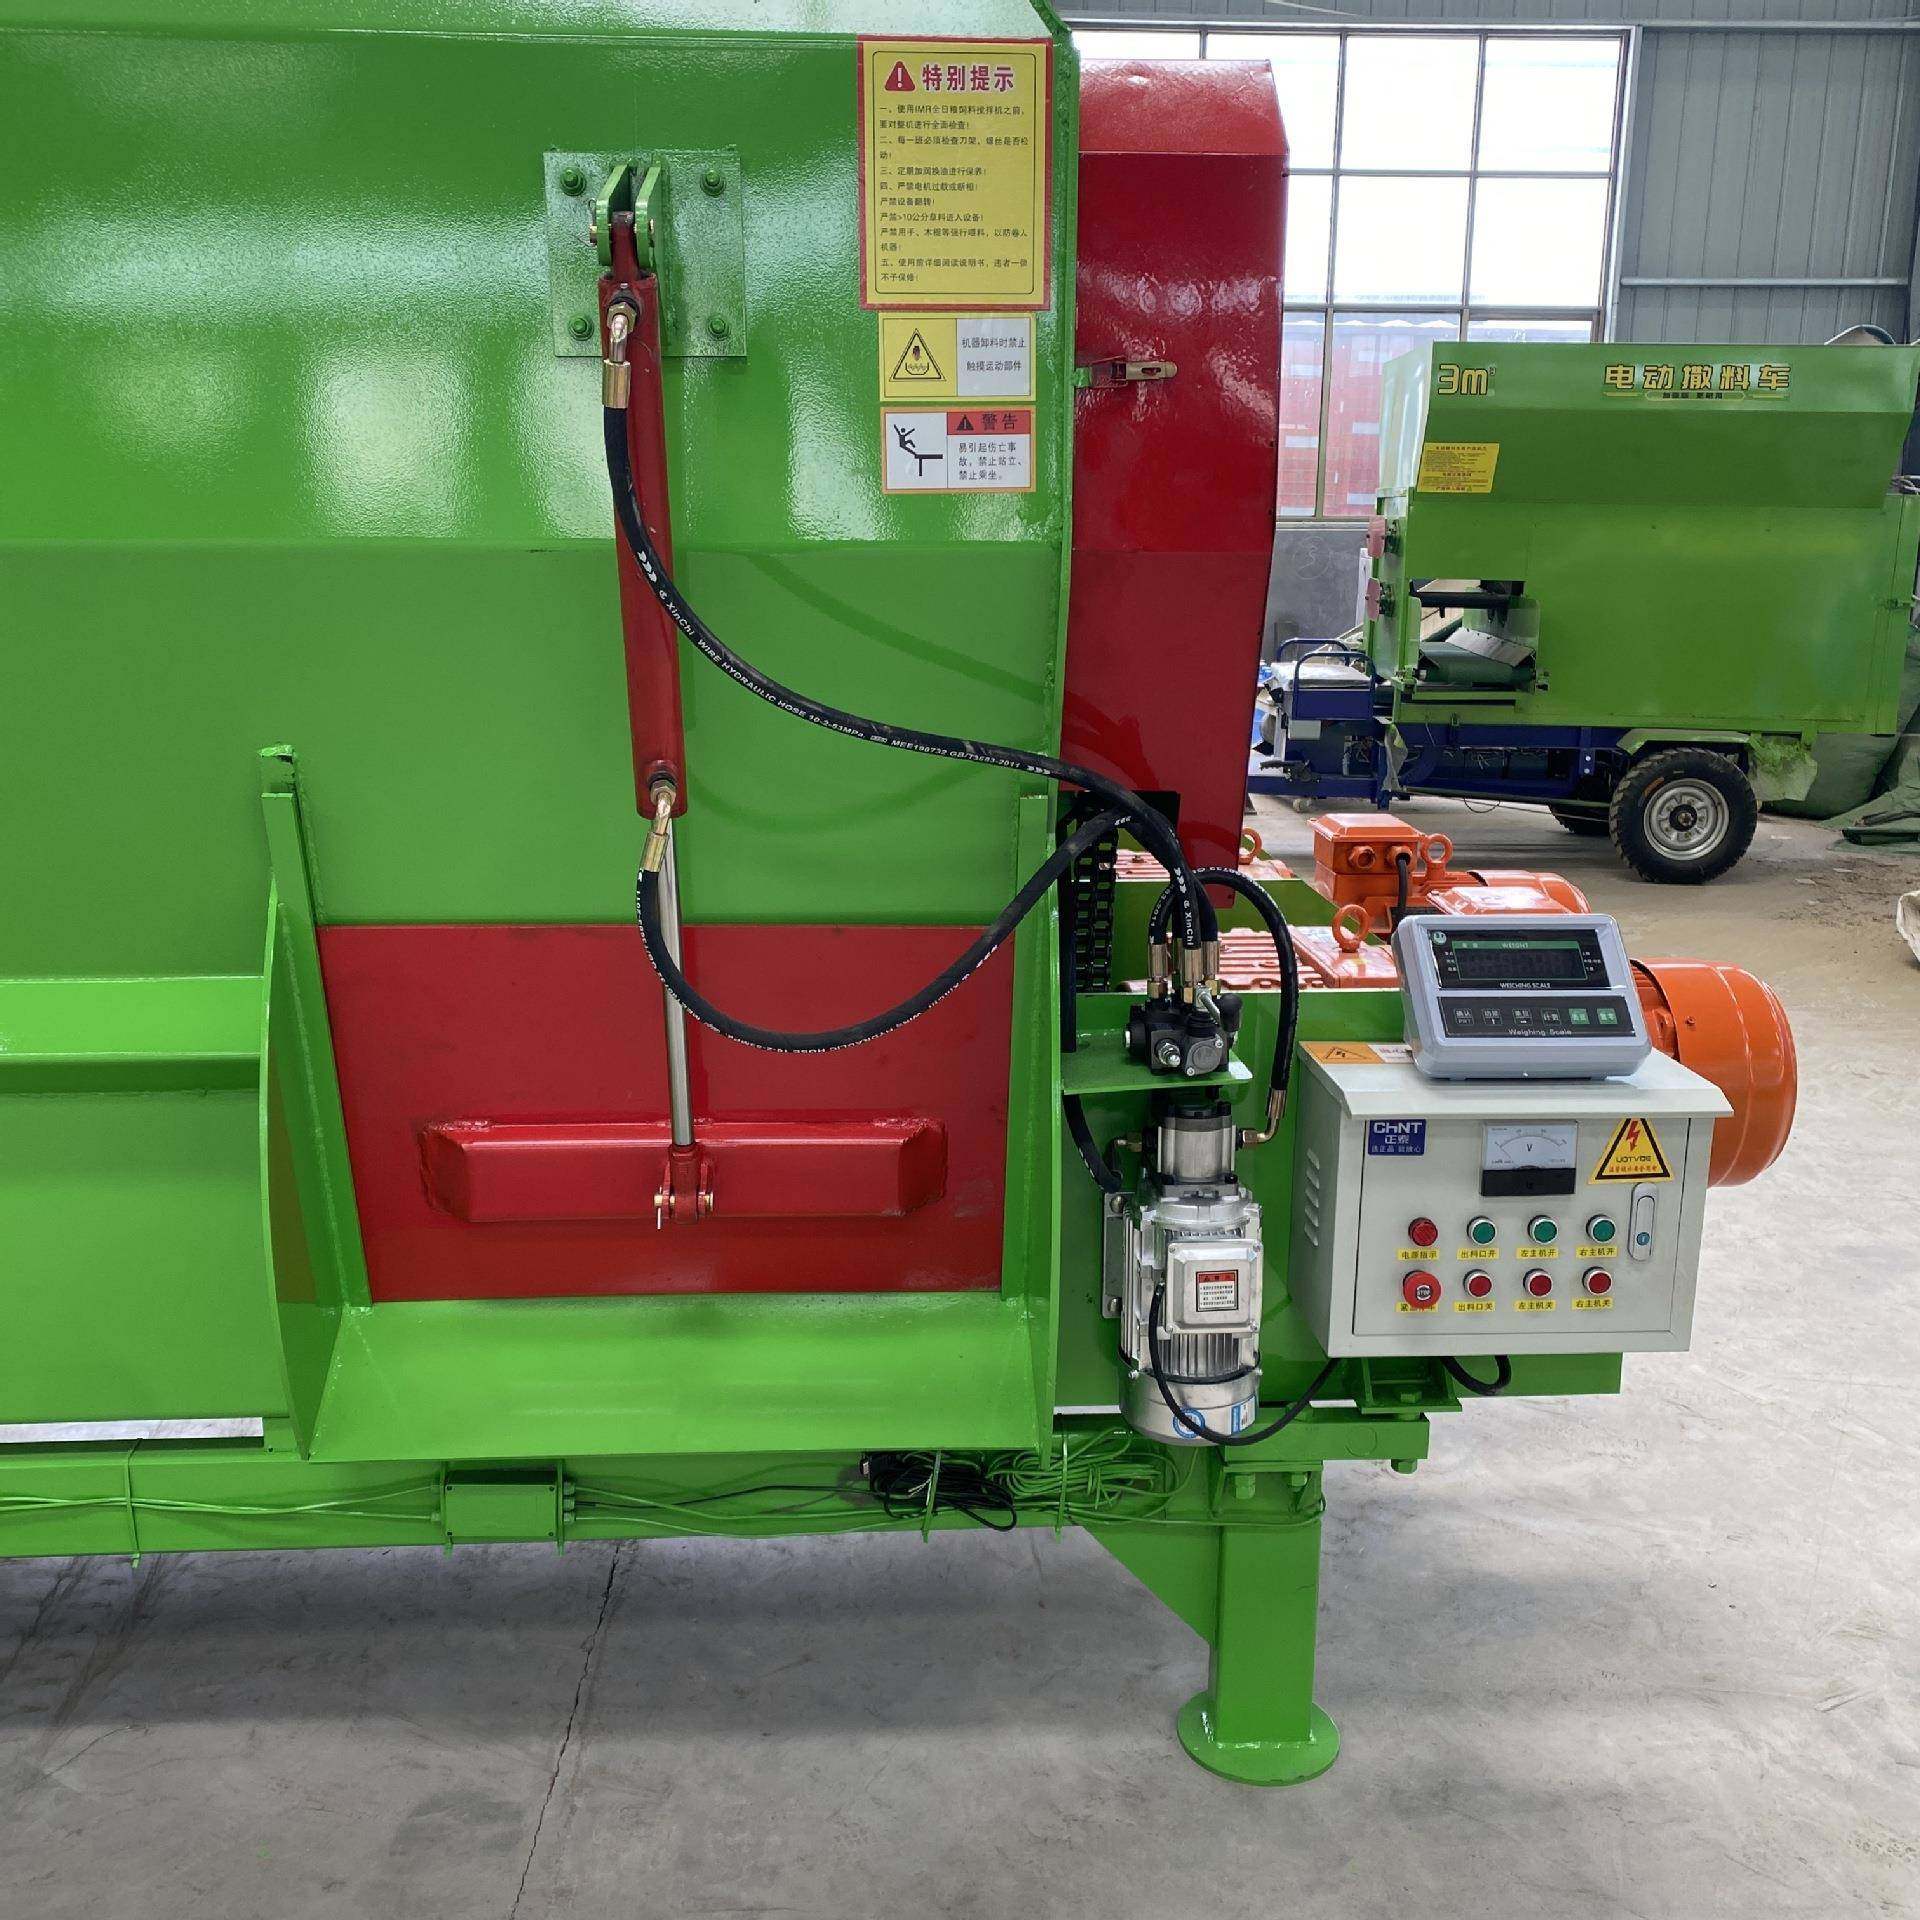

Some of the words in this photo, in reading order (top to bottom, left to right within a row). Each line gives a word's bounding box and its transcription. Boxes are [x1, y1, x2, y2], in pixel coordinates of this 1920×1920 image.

[922, 64, 1014, 92] 特别提示
[962, 337, 1026, 349] 机器卸料时禁止
[967, 360, 1022, 372] 触摸运动部件
[1605, 364, 1791, 391] 电动撒料车
[982, 412, 1018, 431] 警告
[959, 441, 1017, 453] 易引起伤亡事
[666, 602, 695, 635] XinChi
[698, 639, 722, 662] WIRE
[721, 661, 777, 702] HYDRAULIC
[777, 700, 806, 718] HOSE
[1184, 911, 1195, 946] XinChi
[1508, 1028, 1546, 1037] Weighing
[1549, 1028, 1572, 1036] Scale
[1526, 1143, 1533, 1152] V
[1401, 1250, 1438, 1259] 电源指示
[1461, 1249, 1497, 1259] 出料口开
[1520, 1248, 1557, 1257] 左主机开
[1579, 1247, 1615, 1256] 右主机开
[1416, 1288, 1431, 1296] STOP
[1458, 1302, 1494, 1311] 出料口关
[1518, 1301, 1554, 1310] 左主机关
[1575, 1299, 1611, 1308] 右主机关
